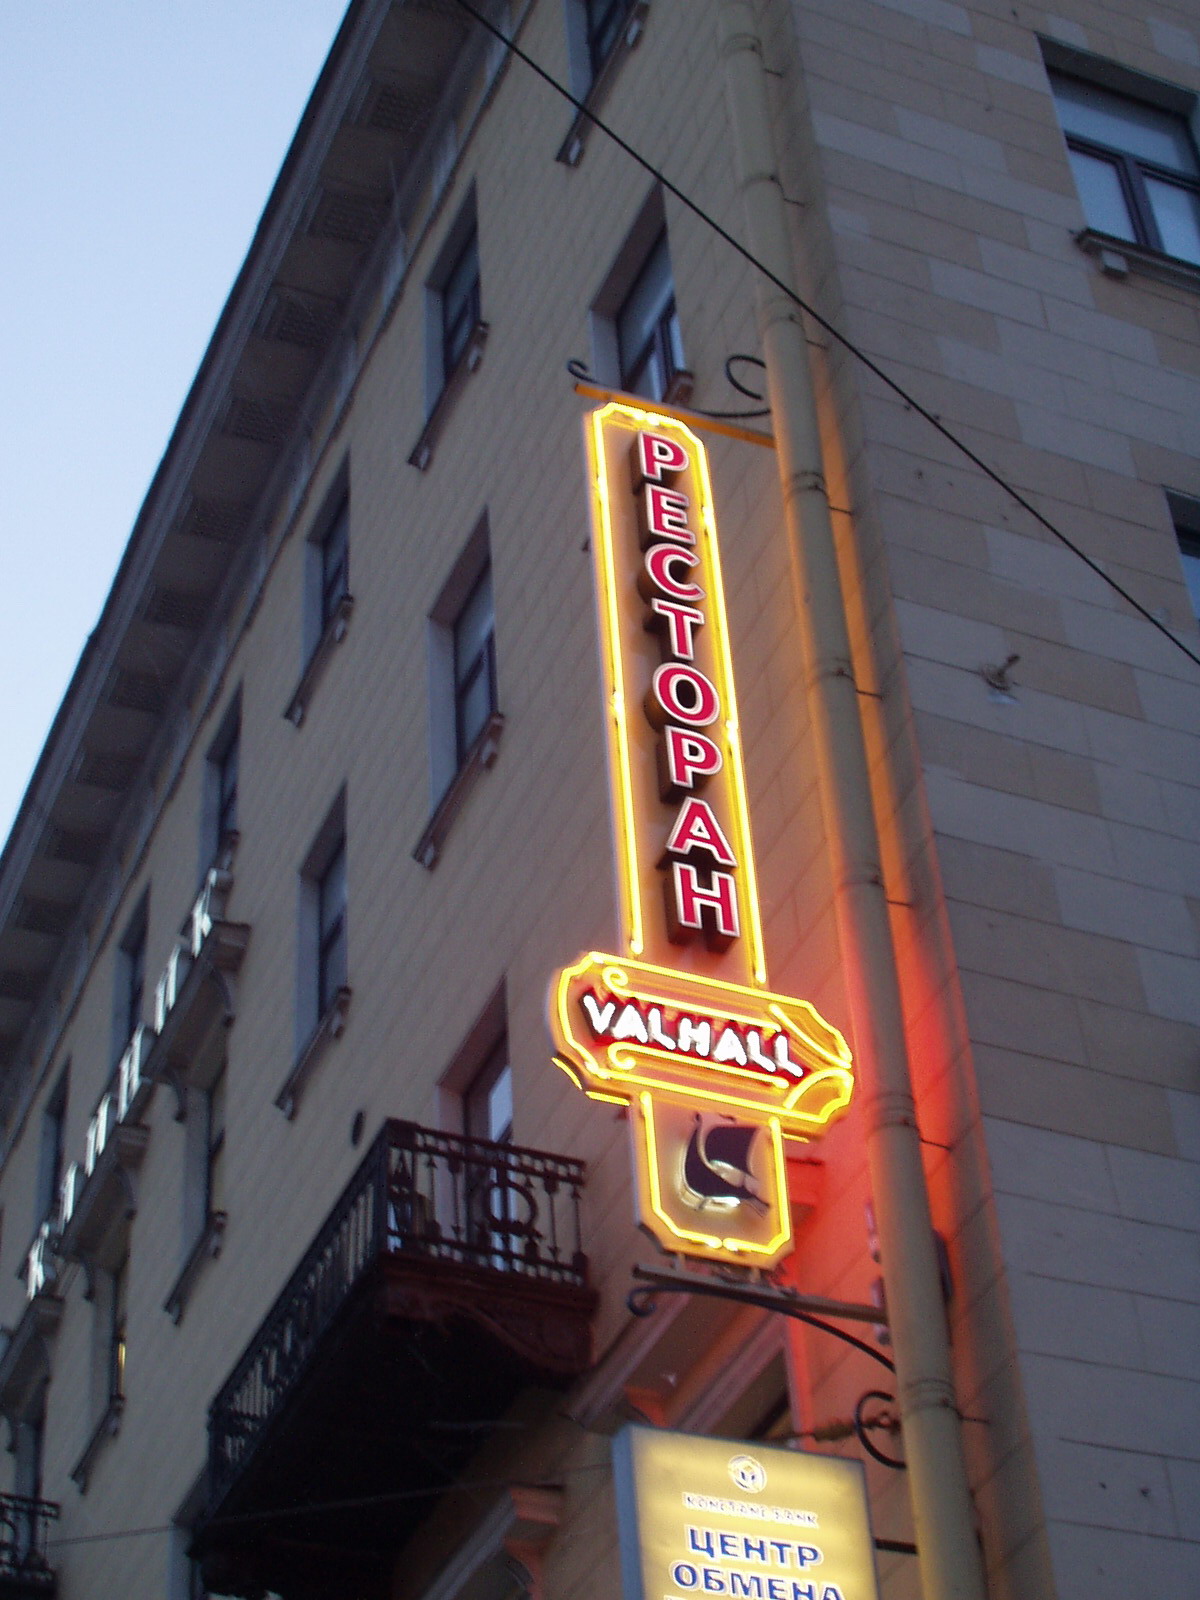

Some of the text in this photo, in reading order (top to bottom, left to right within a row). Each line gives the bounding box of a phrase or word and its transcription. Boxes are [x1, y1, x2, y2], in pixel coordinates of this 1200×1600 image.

[637, 430, 741, 938] РЕСТОРАН
[582, 994, 804, 1078] VALHALL
[689, 1527, 819, 1567] ЦЕНТР
[673, 1563, 844, 1600] ОБМЕНА
